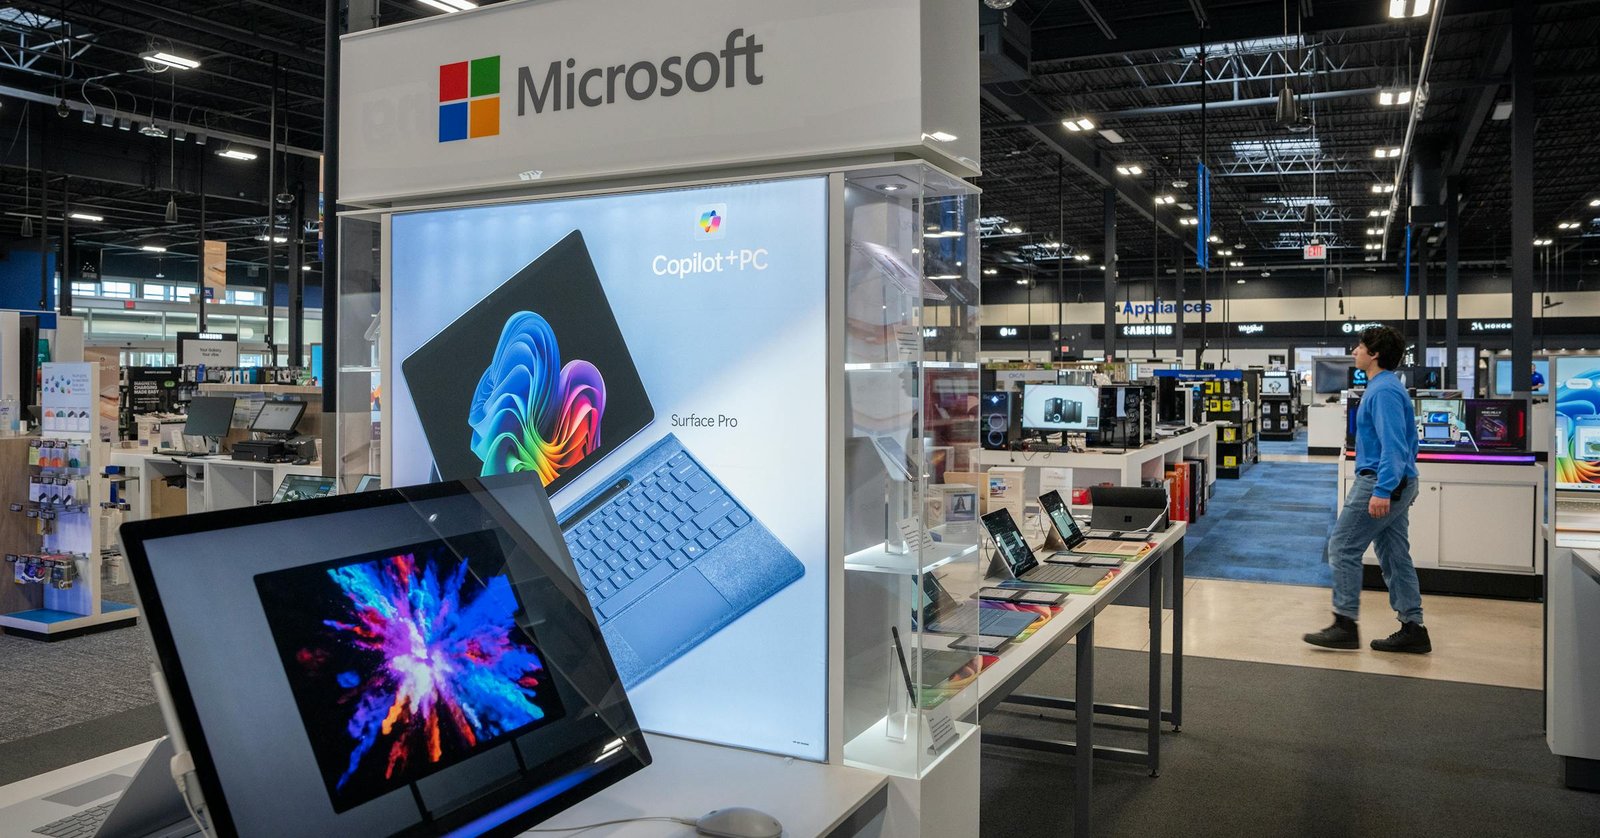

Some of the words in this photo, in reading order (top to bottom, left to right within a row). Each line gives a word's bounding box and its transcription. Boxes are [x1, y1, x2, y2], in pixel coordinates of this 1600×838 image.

[517, 28, 764, 117] Microsoft
[1307, 246, 1322, 257] EXIT
[1123, 297, 1213, 318] Appliaces
[1123, 325, 1173, 336] SAMSUNG
[671, 413, 715, 428] Surface
[718, 414, 738, 428] Pro
